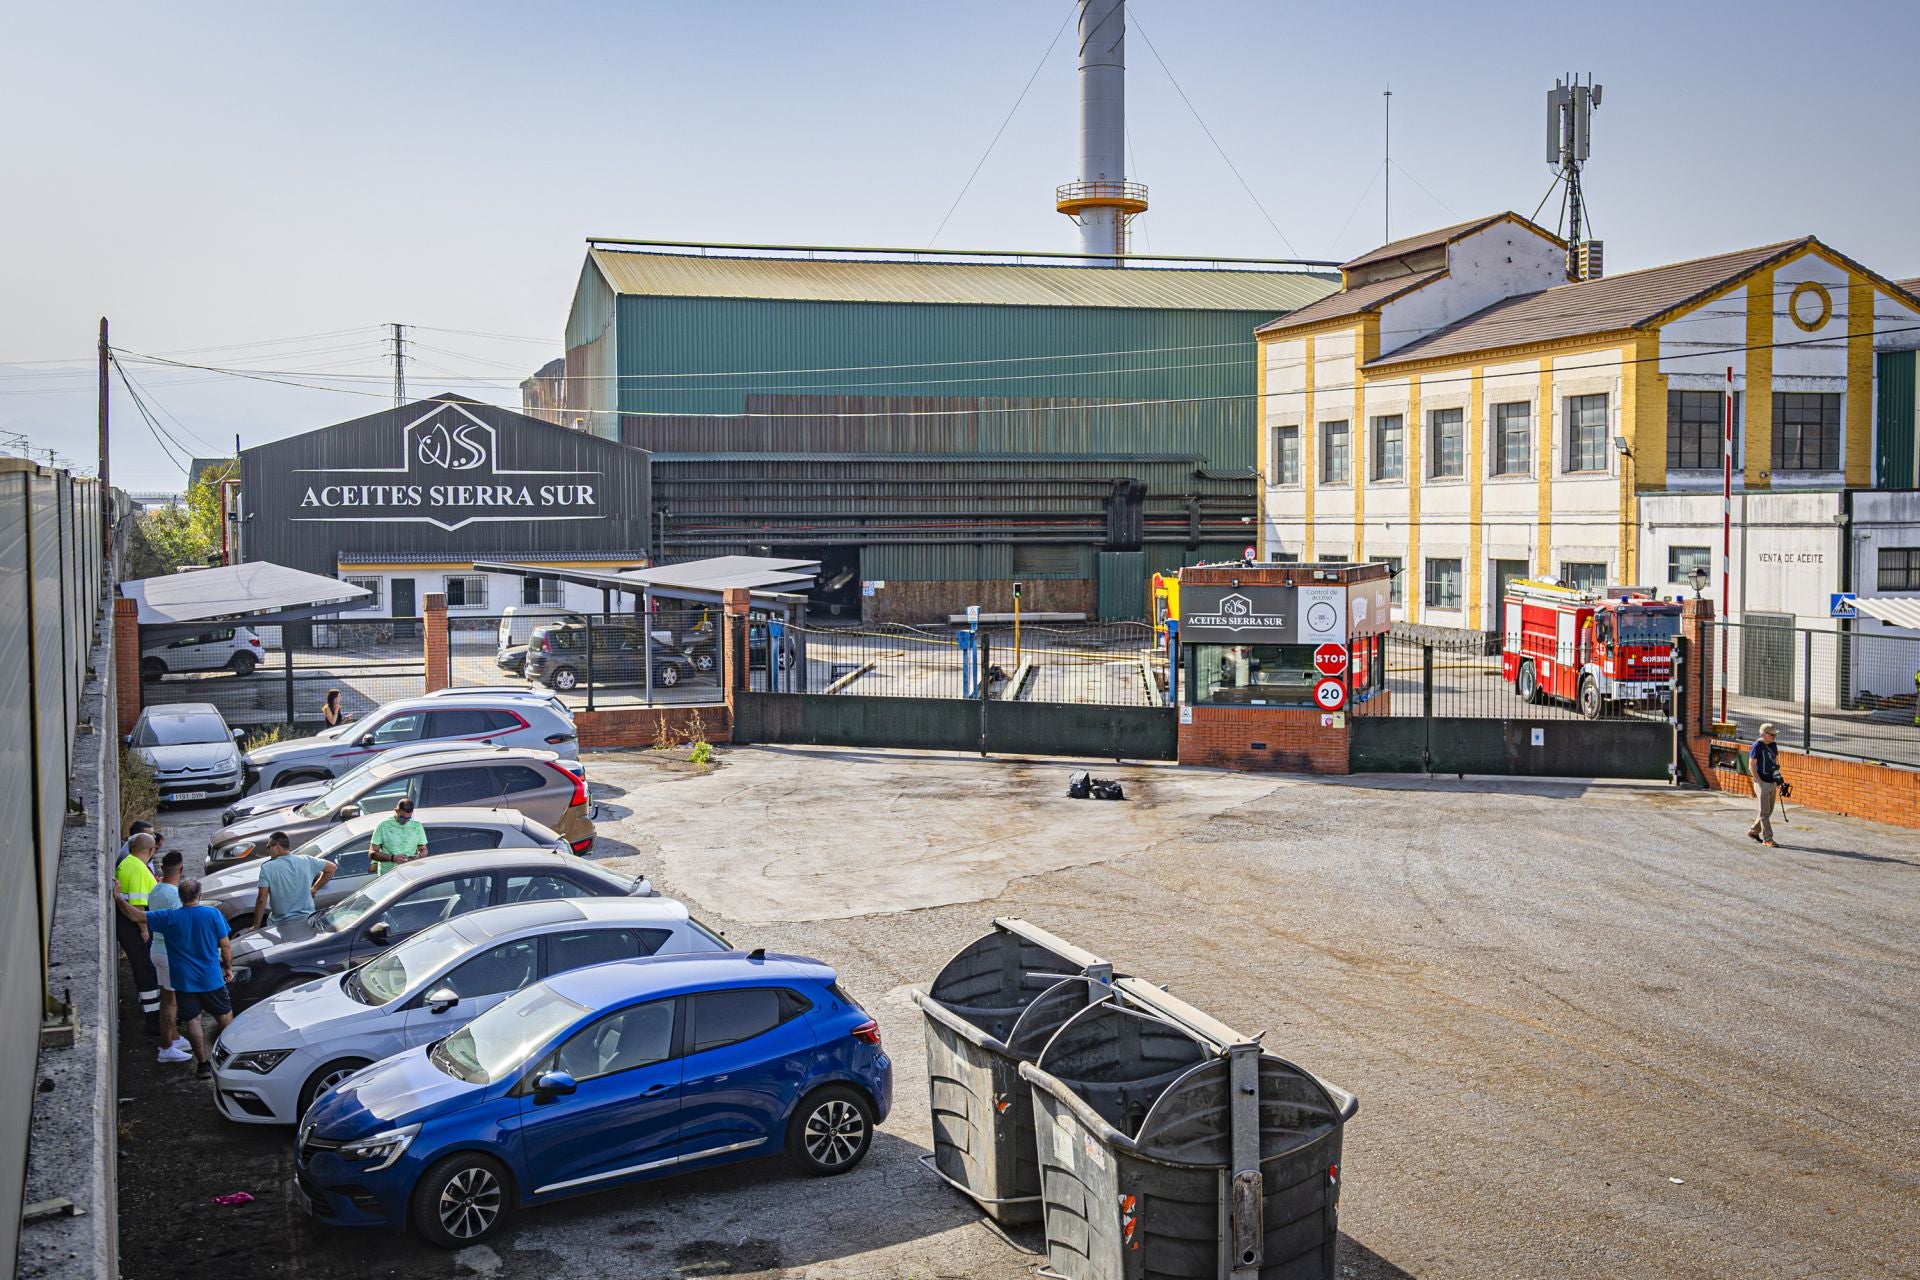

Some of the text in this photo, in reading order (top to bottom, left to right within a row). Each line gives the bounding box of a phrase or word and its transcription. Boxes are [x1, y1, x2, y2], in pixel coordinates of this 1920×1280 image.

[300, 484, 596, 507] ACEITES SIERRA SUR
[1759, 553, 1824, 564] VENTA DE ACEITE
[1188, 616, 1283, 626] ACEITES SIERRA SUR
[1316, 655, 1346, 664] STOP
[1321, 688, 1340, 700] 20
